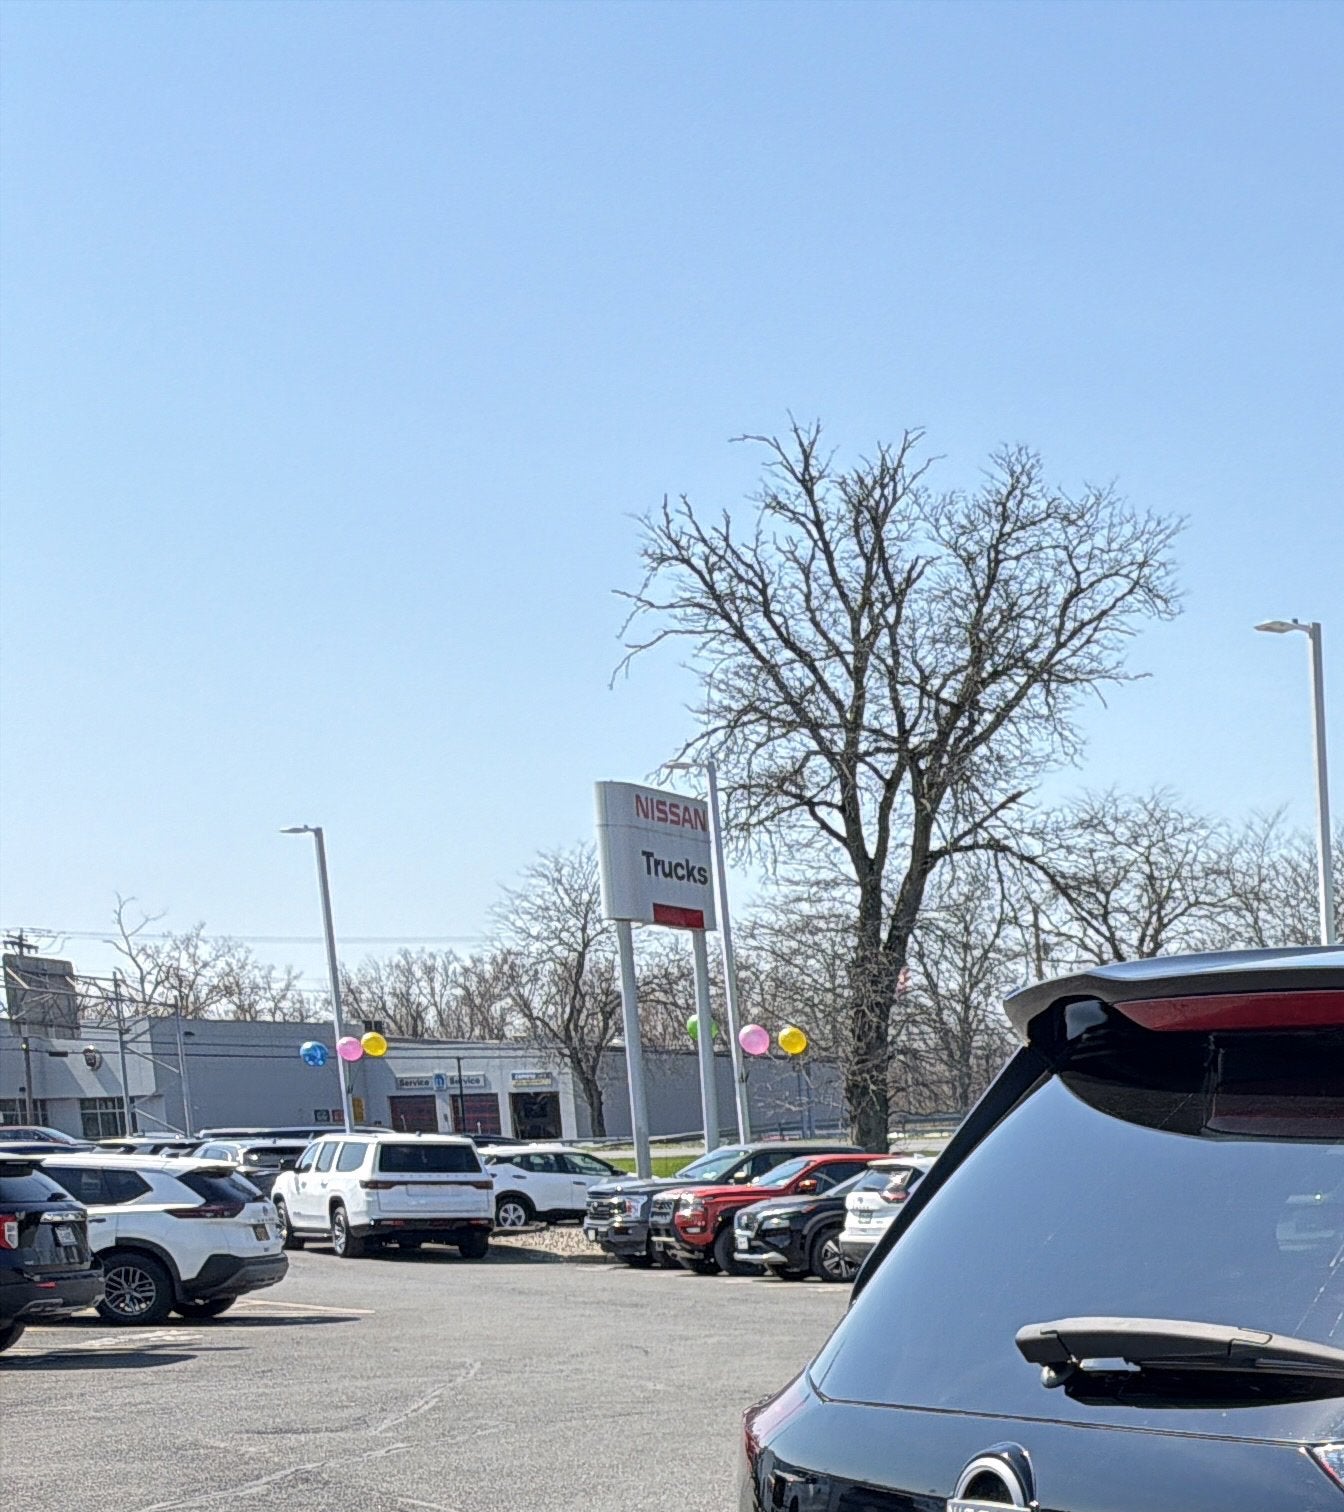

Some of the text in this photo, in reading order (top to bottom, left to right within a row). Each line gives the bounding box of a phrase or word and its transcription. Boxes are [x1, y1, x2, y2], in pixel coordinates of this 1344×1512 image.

[635, 794, 708, 832] NISSAN
[642, 850, 708, 885] Trucks
[399, 1078, 430, 1087] Service
[449, 1076, 480, 1085] Sevice
